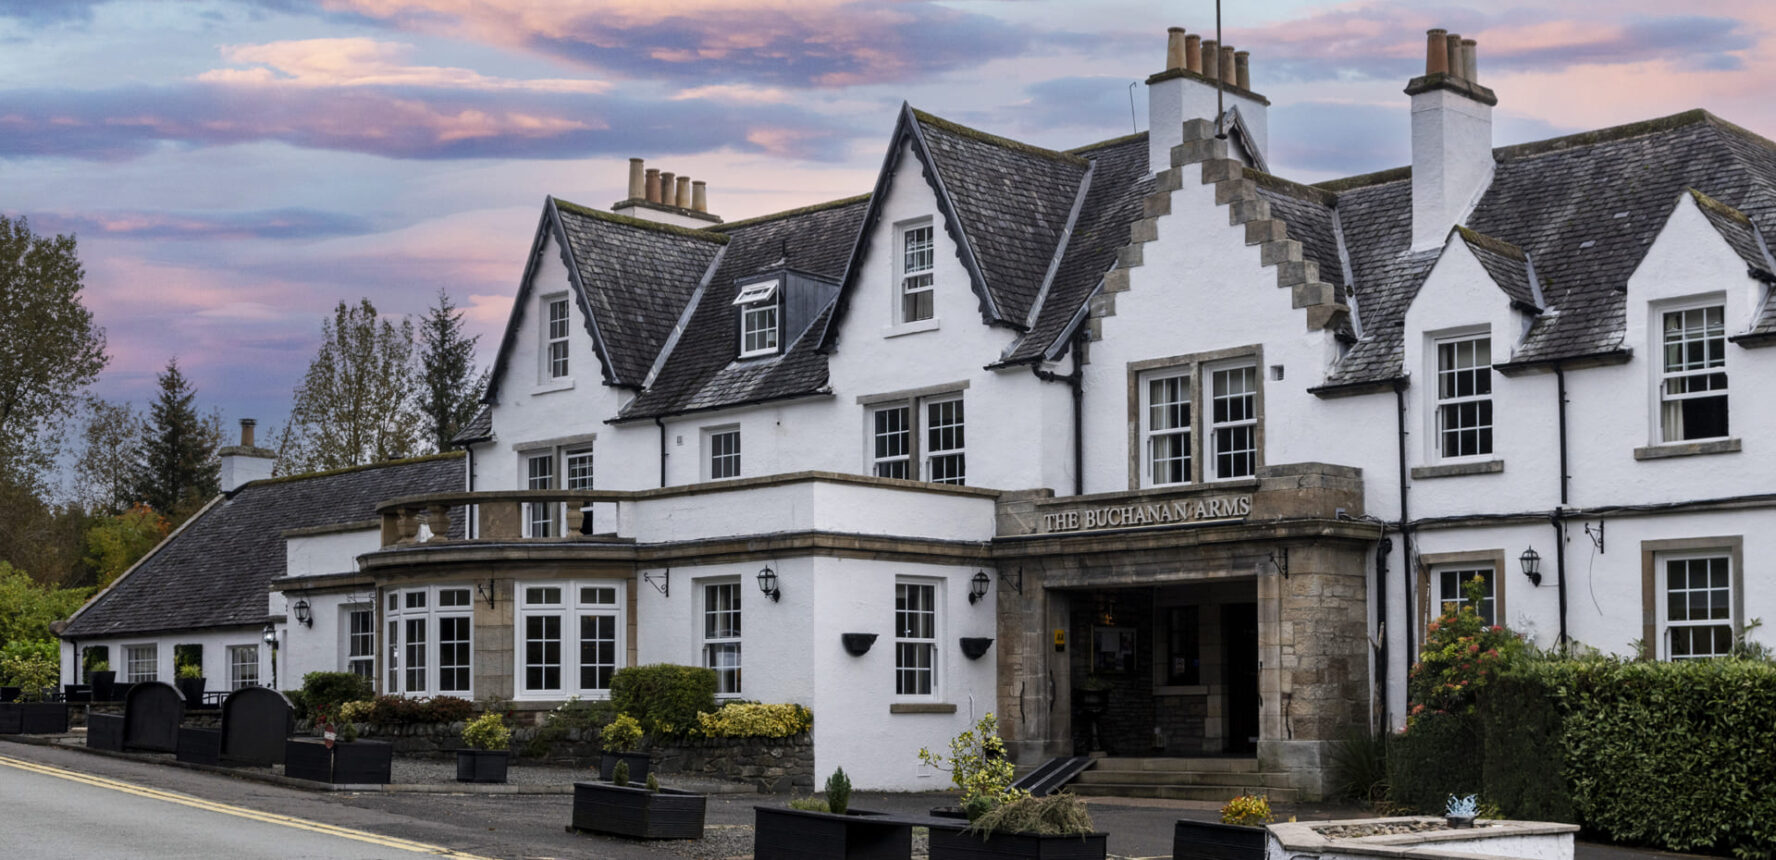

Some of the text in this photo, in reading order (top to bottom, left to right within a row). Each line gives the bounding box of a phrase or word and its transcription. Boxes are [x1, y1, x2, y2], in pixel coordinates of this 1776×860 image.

[1044, 496, 1249, 530] THE BUCHANAN ARMS
